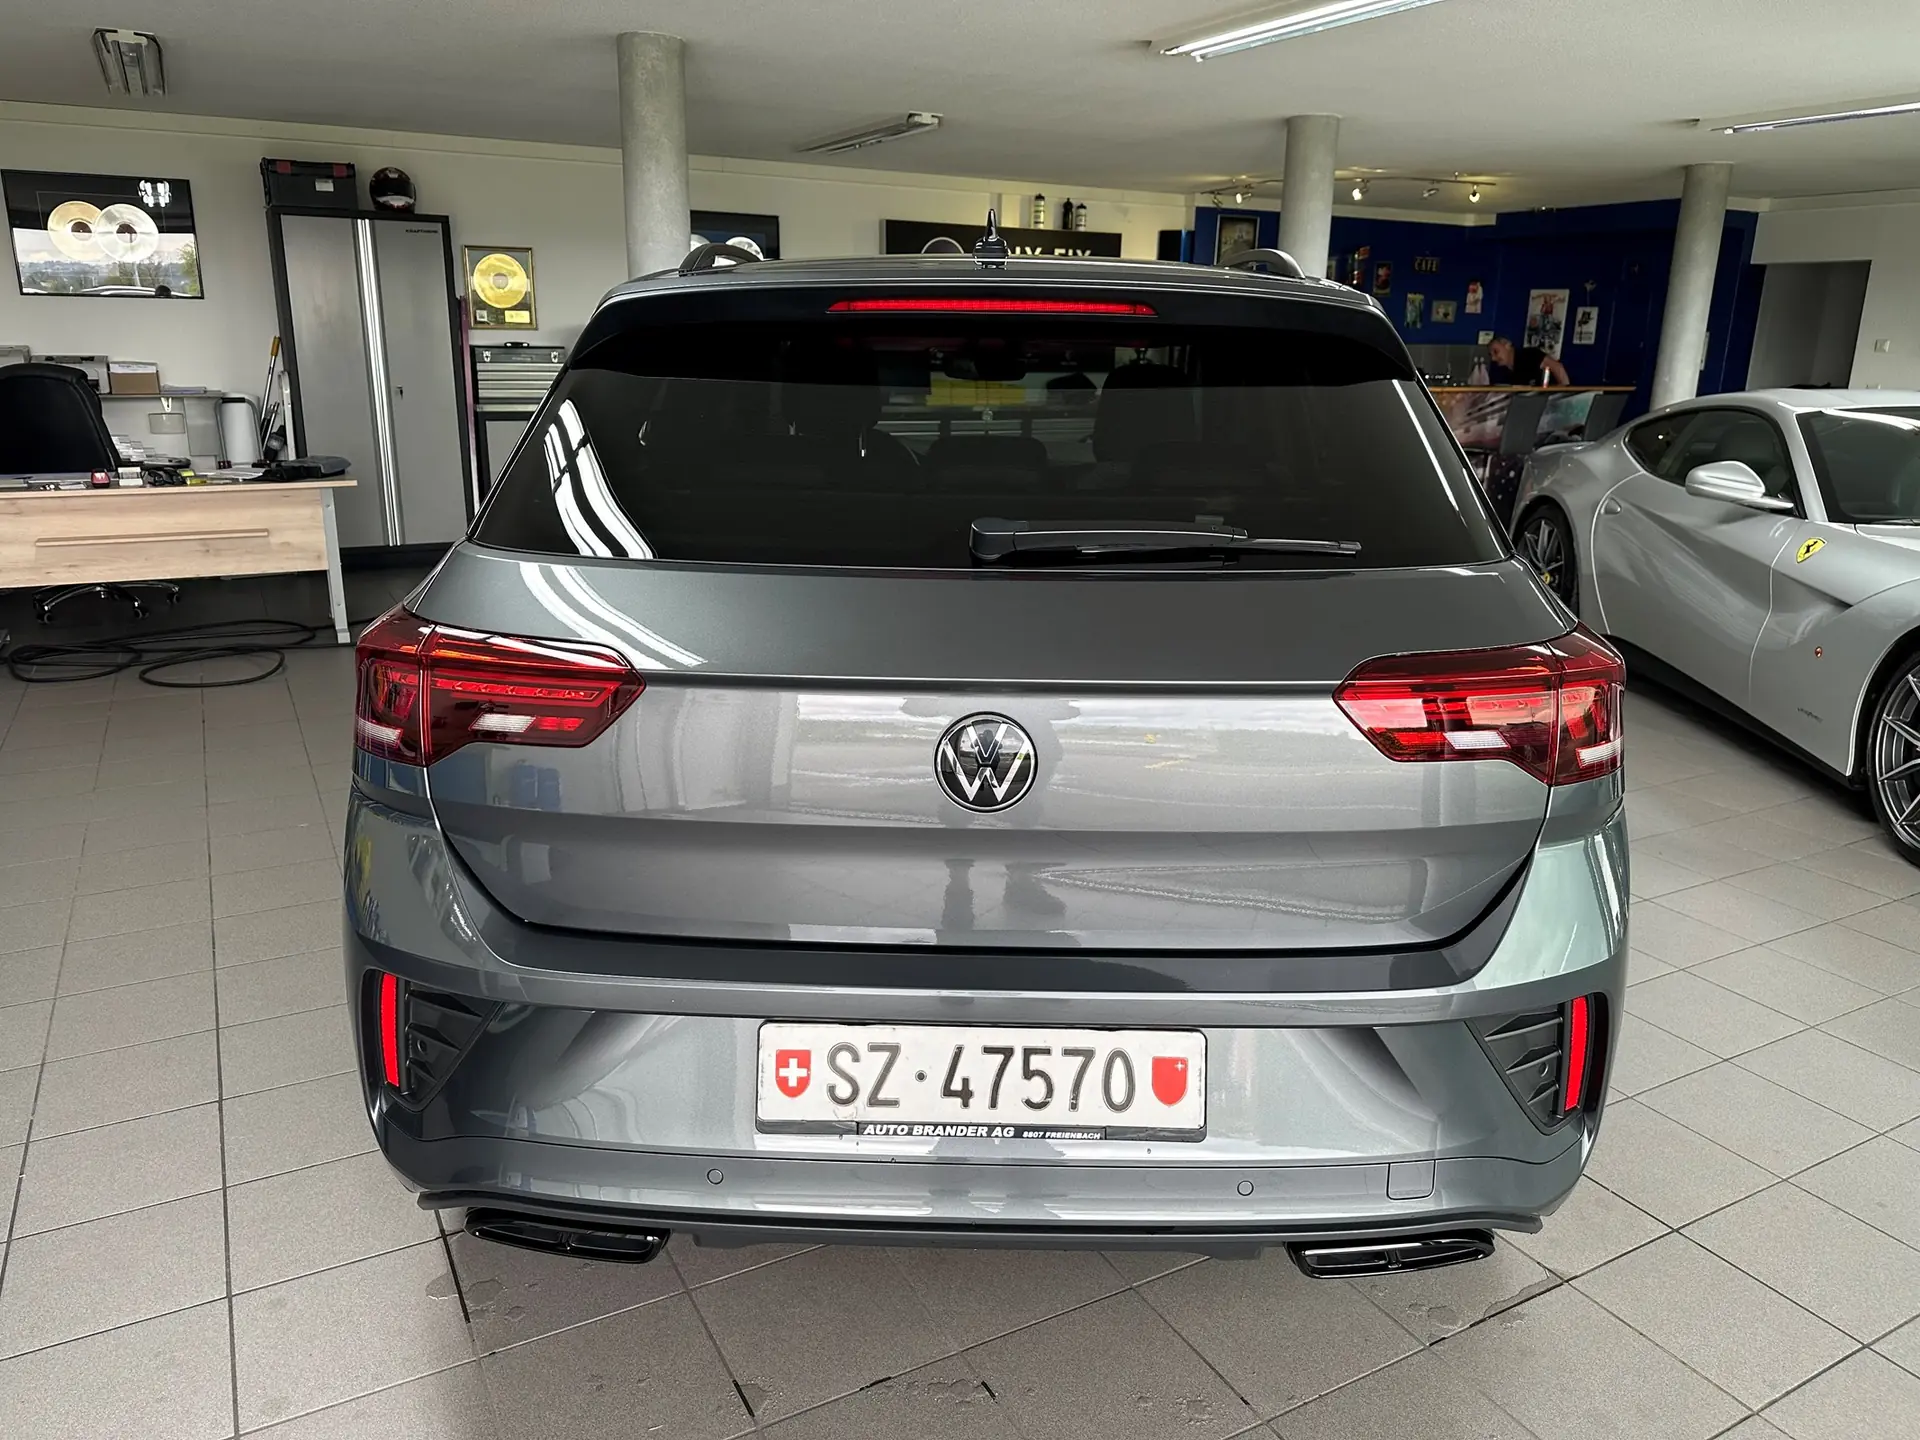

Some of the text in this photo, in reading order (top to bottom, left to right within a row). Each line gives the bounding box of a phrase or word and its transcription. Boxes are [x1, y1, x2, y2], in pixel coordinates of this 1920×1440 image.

[826, 1042, 901, 1108] SZ
[940, 1044, 1136, 1113] 47570
[863, 1124, 908, 1135] AUTO
[912, 1125, 987, 1137] BRANDER
[991, 1127, 1015, 1138] AG
